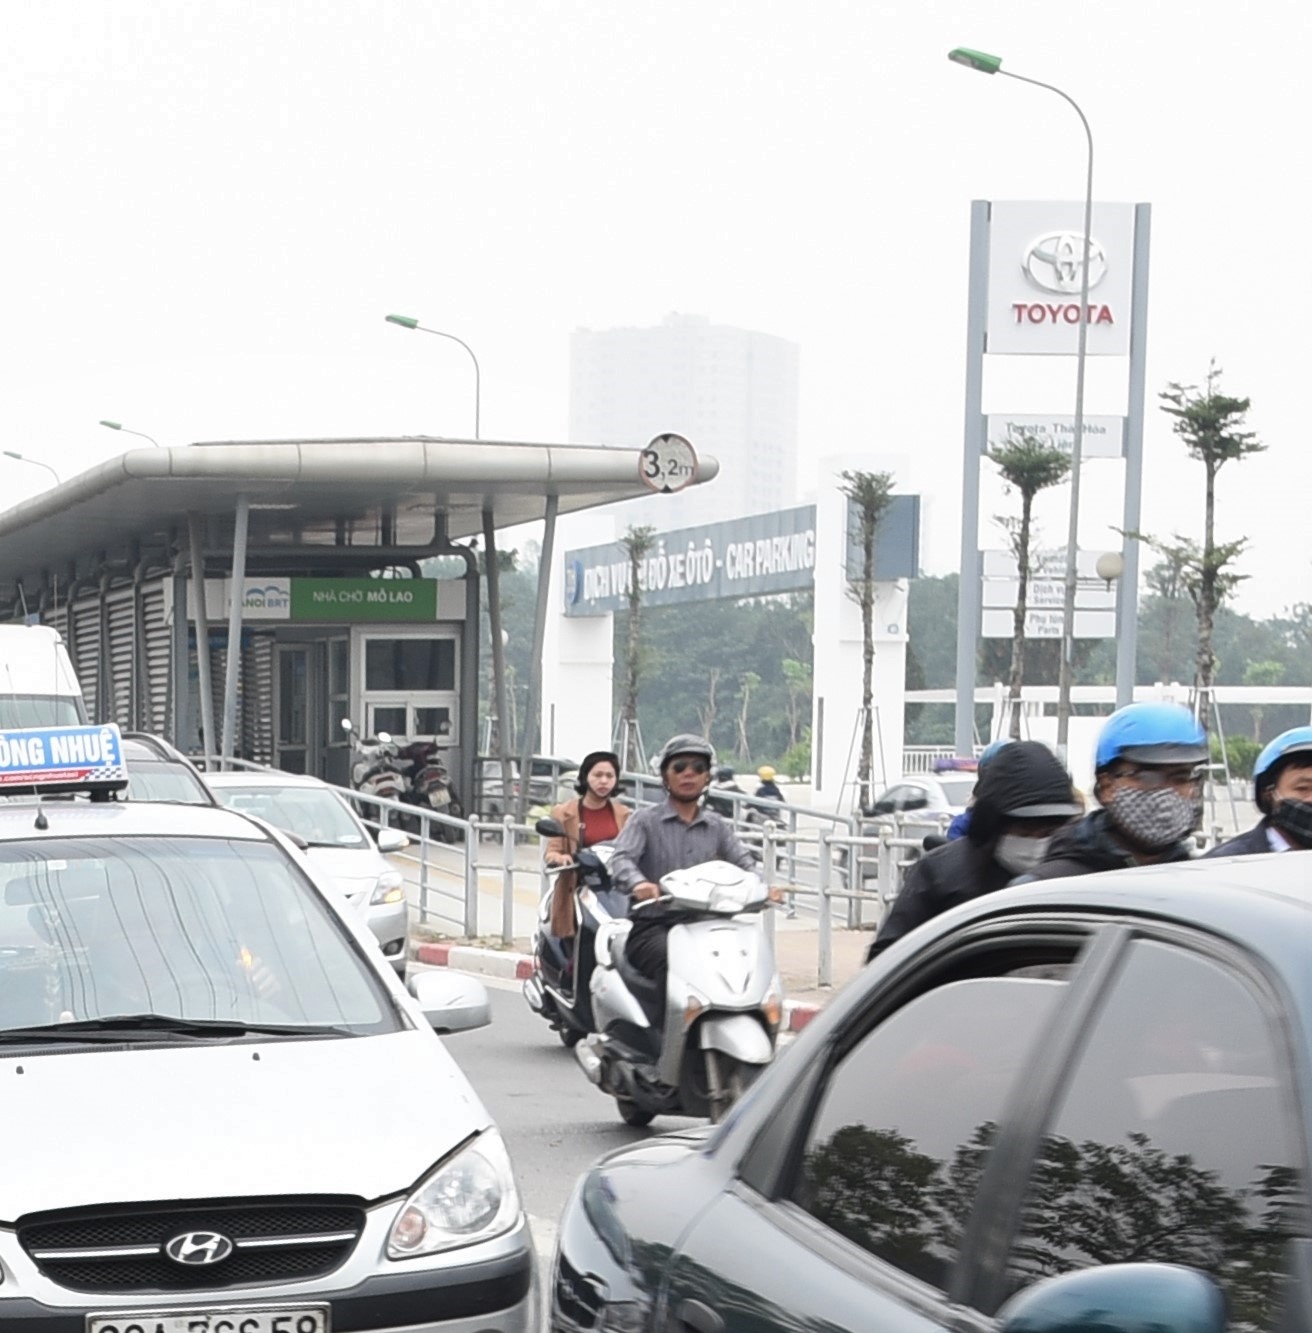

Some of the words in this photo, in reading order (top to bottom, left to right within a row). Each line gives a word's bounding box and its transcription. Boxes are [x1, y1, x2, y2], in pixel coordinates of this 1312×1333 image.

[1012, 303, 1114, 324] TOYOTA
[668, 554, 686, 588] XE
[727, 541, 754, 580] CAR
[756, 530, 814, 575] PARKING
[267, 598, 288, 608] BRT
[313, 588, 337, 603] NHÀ
[389, 590, 413, 603] LAO
[50, 726, 116, 766] NHUỆ
